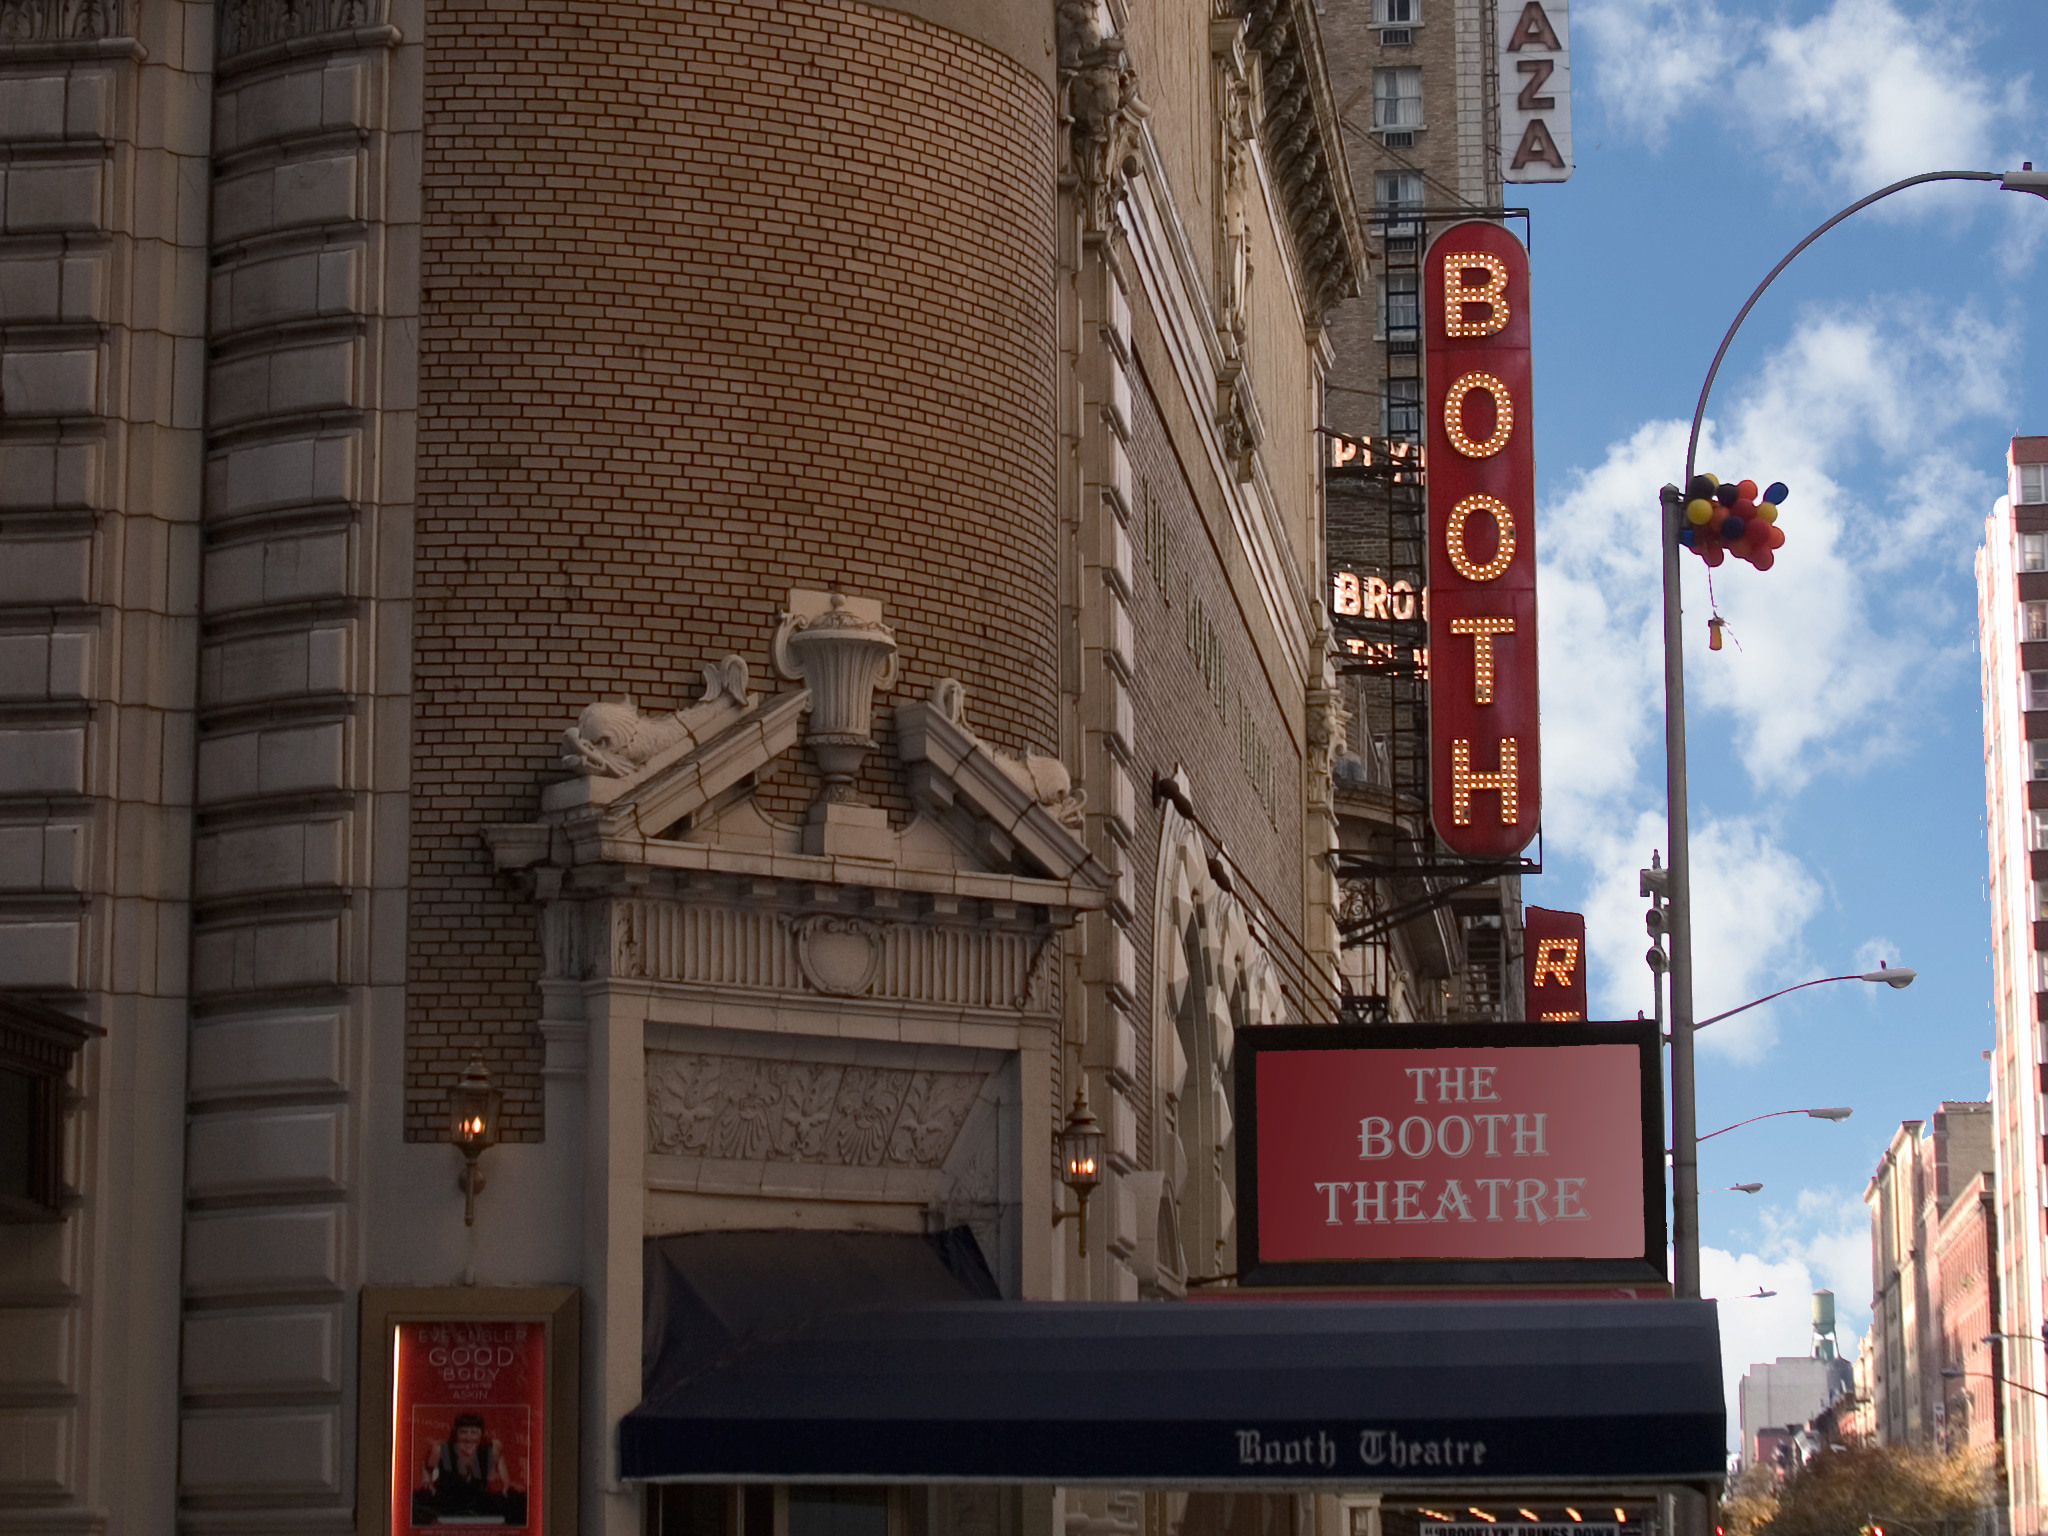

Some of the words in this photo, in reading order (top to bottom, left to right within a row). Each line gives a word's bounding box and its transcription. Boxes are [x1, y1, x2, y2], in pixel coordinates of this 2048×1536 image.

[1442, 251, 1519, 828] BOOTH
[1404, 1066, 1502, 1104] THE
[1357, 1112, 1550, 1161] BOOTH
[1314, 1177, 1592, 1226] THEATRE
[428, 1346, 515, 1367] GOOD
[443, 1367, 500, 1382] BODY
[1235, 1429, 1337, 1469] Booth
[1359, 1429, 1487, 1469] Theatre
